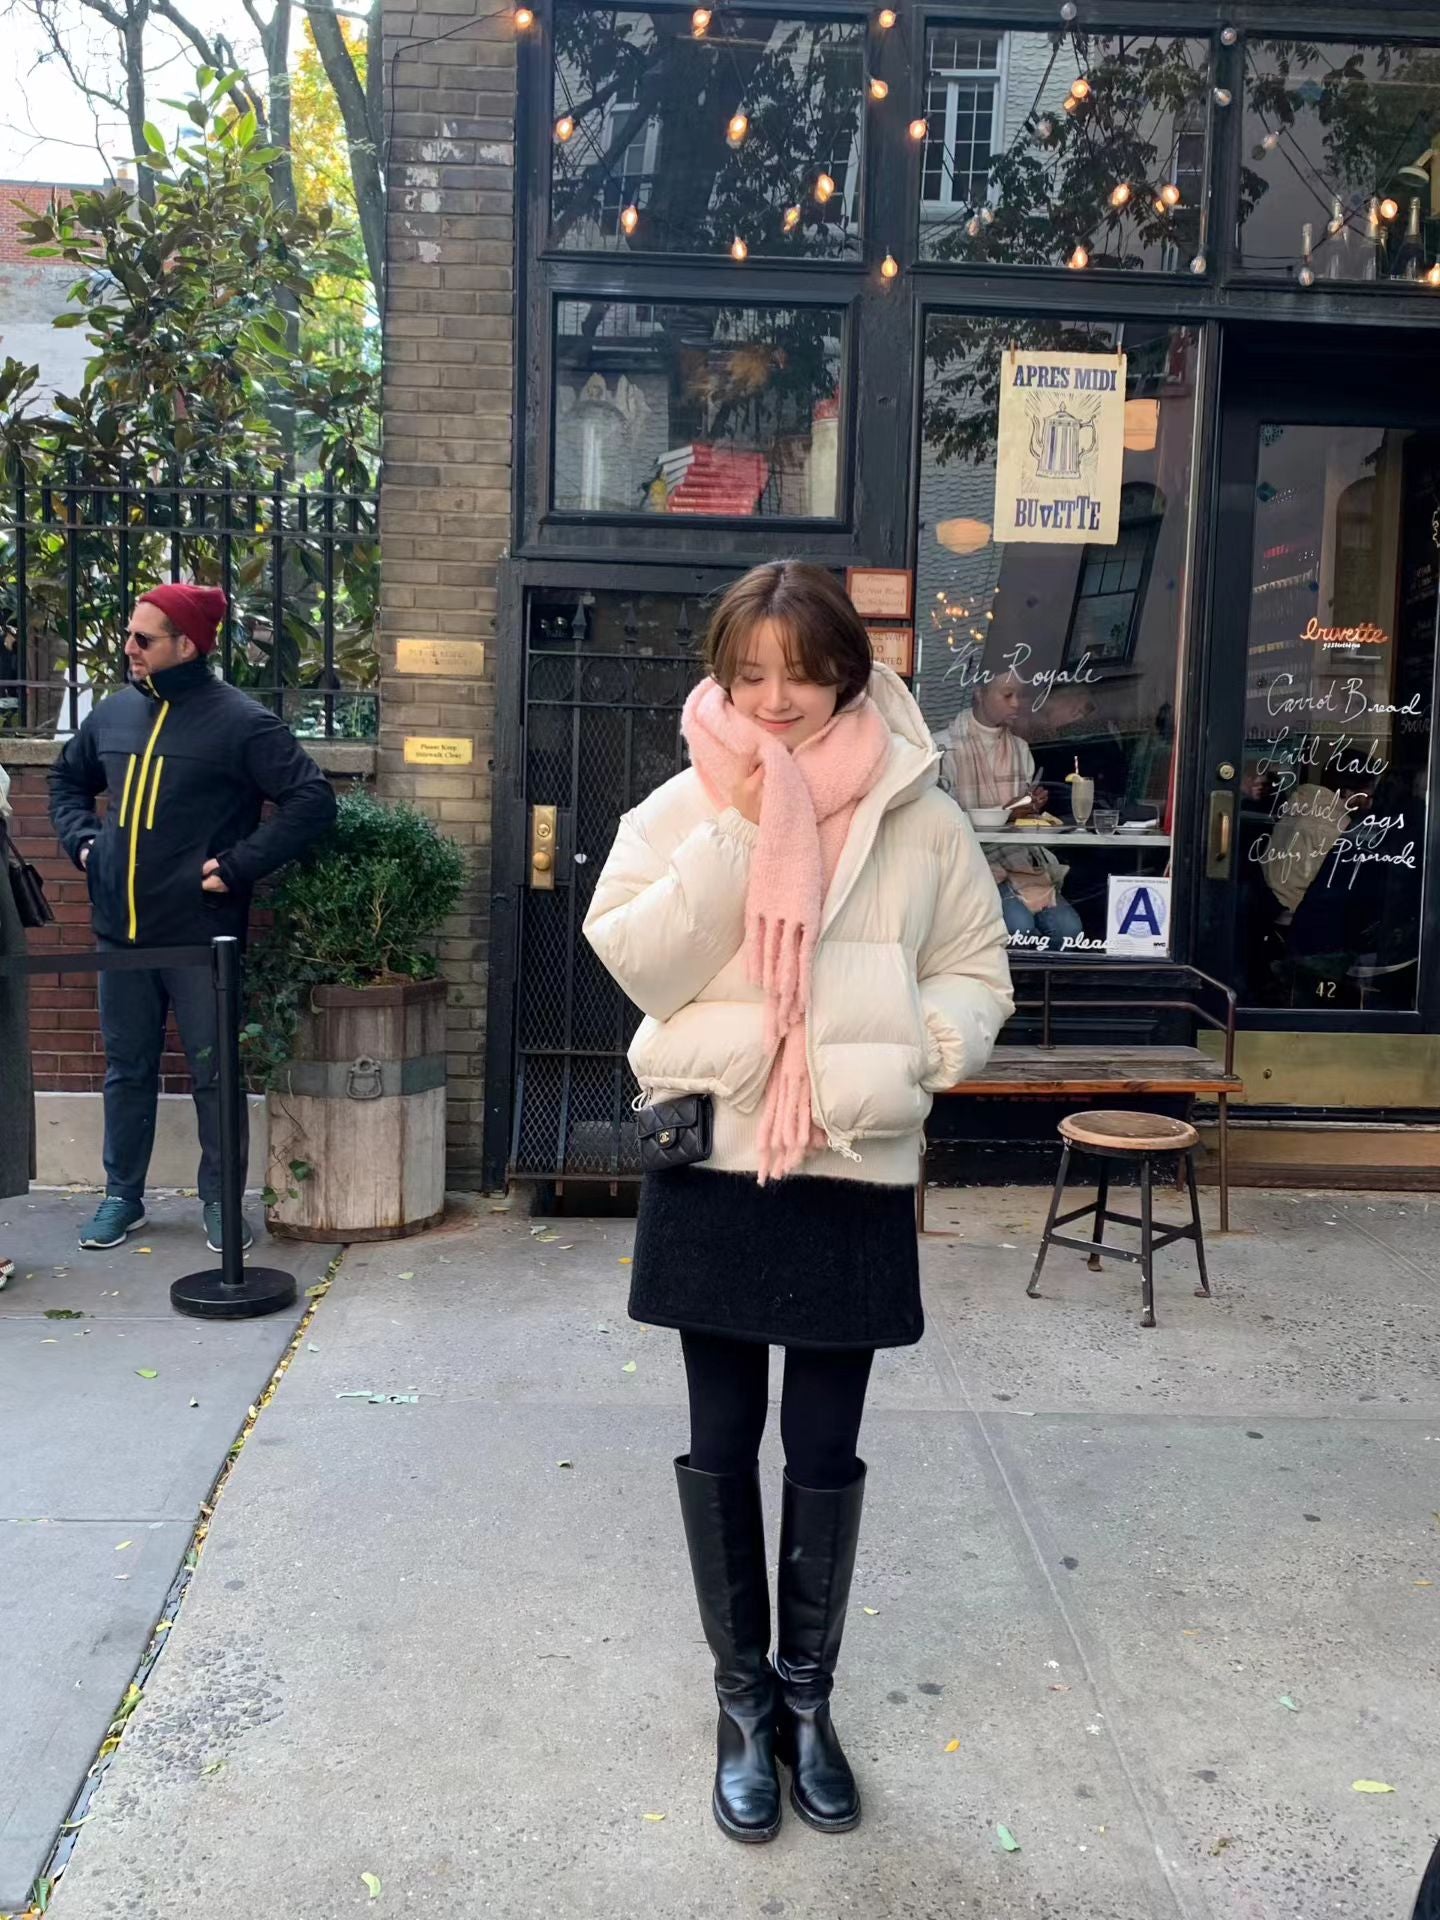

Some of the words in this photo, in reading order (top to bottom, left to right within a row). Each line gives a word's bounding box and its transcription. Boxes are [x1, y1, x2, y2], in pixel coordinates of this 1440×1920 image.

[1013, 365, 1070, 389] APRES
[1073, 368, 1117, 391] MIDI
[1300, 617, 1388, 643] buvette
[942, 640, 995, 687] Kir
[1003, 642, 1103, 713] Royale
[1267, 673, 1338, 717] Carrot
[1340, 678, 1422, 724] Bread
[1256, 725, 1321, 776] Lentil
[1325, 733, 1390, 776] Kale
[1269, 771, 1341, 823] Poached
[1337, 792, 1406, 850] Eggs
[1117, 887, 1162, 936] A
[1315, 981, 1337, 998] 42
